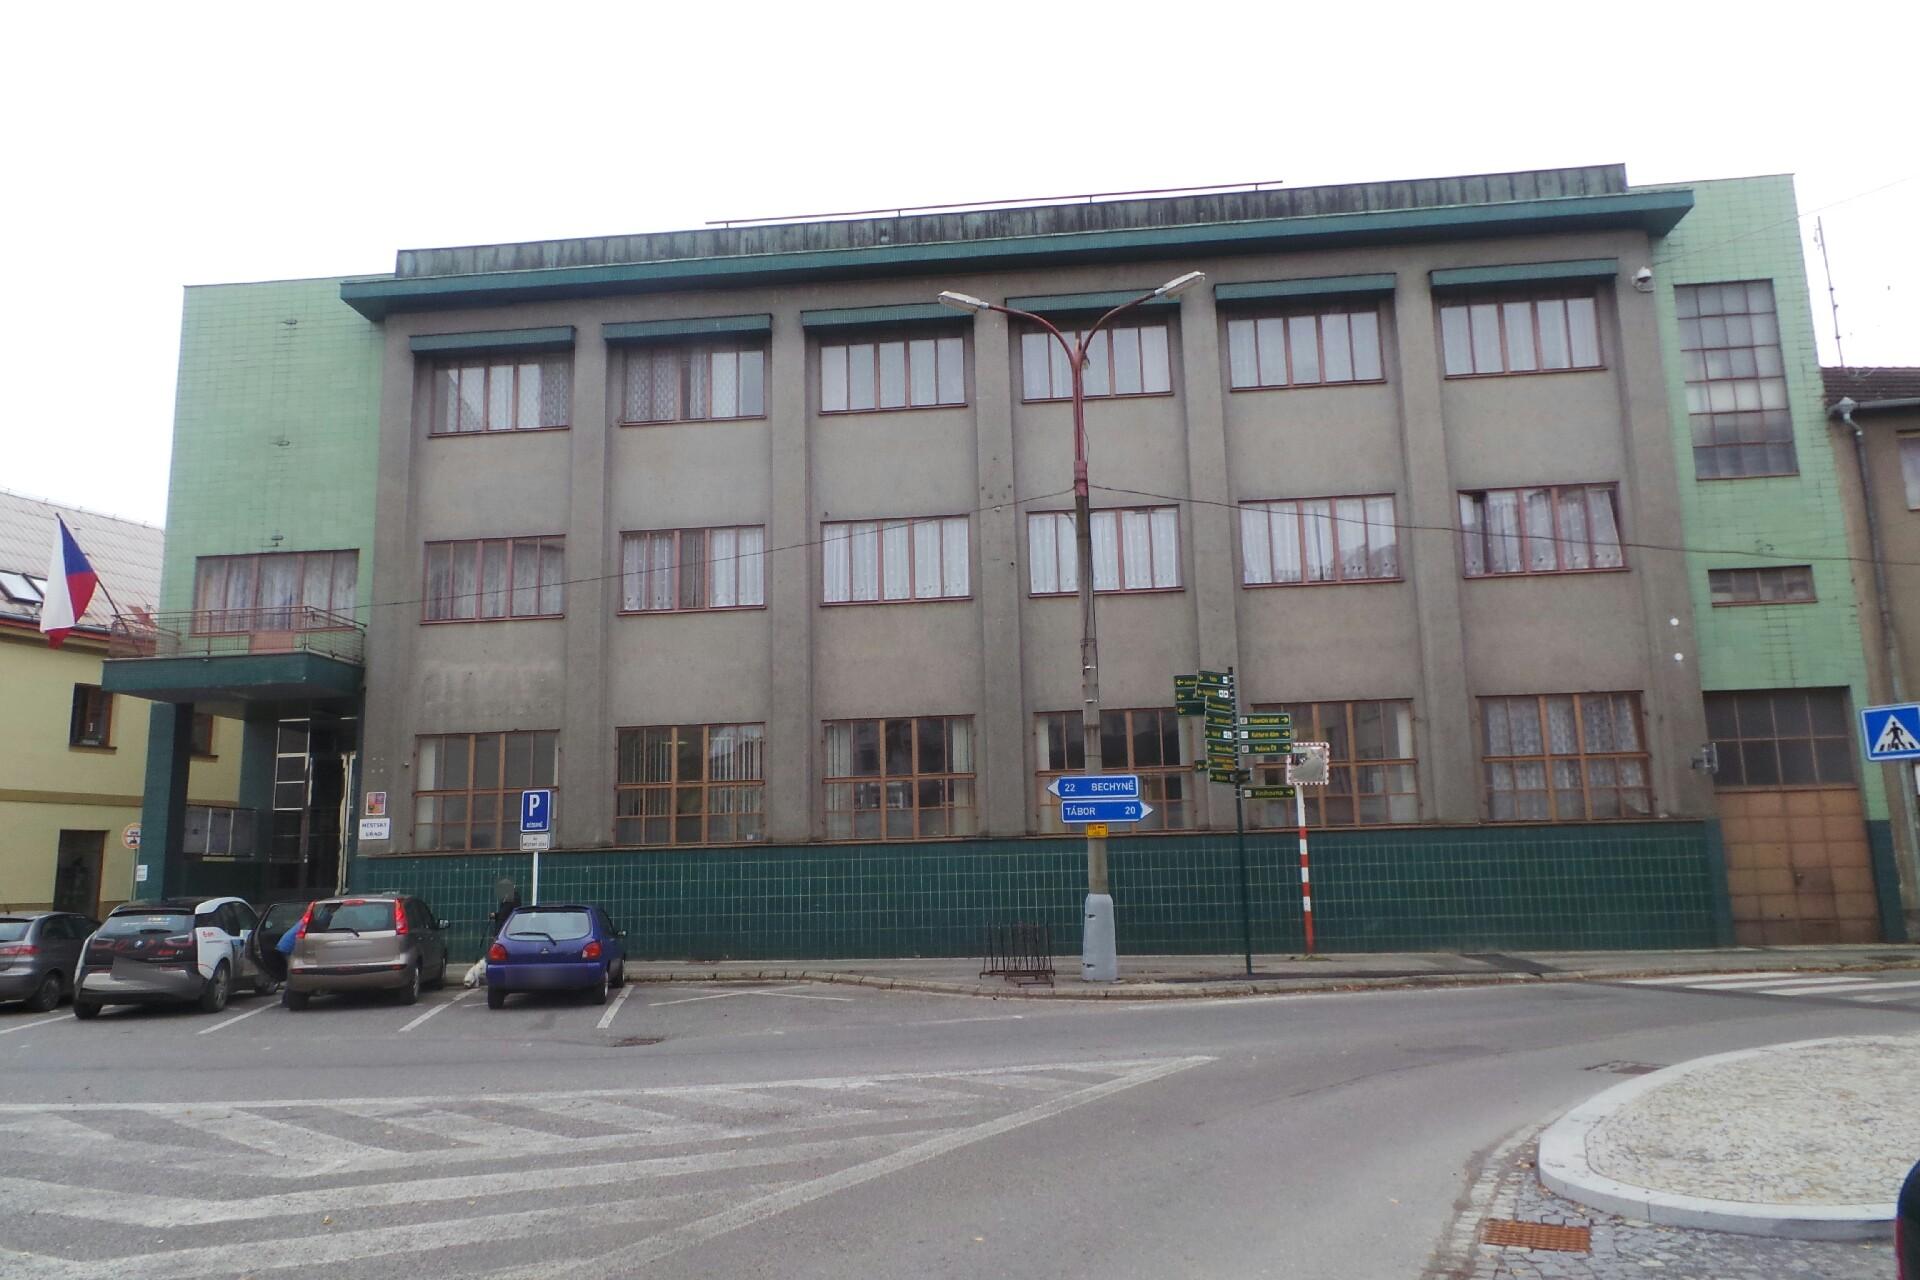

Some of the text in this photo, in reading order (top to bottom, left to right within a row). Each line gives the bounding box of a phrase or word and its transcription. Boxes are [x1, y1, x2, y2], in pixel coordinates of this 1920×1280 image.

[1064, 780, 1134, 792] 22 BECHYNĚ
[529, 794, 540, 817] P
[1065, 805, 1136, 816] TÁBOR 20
